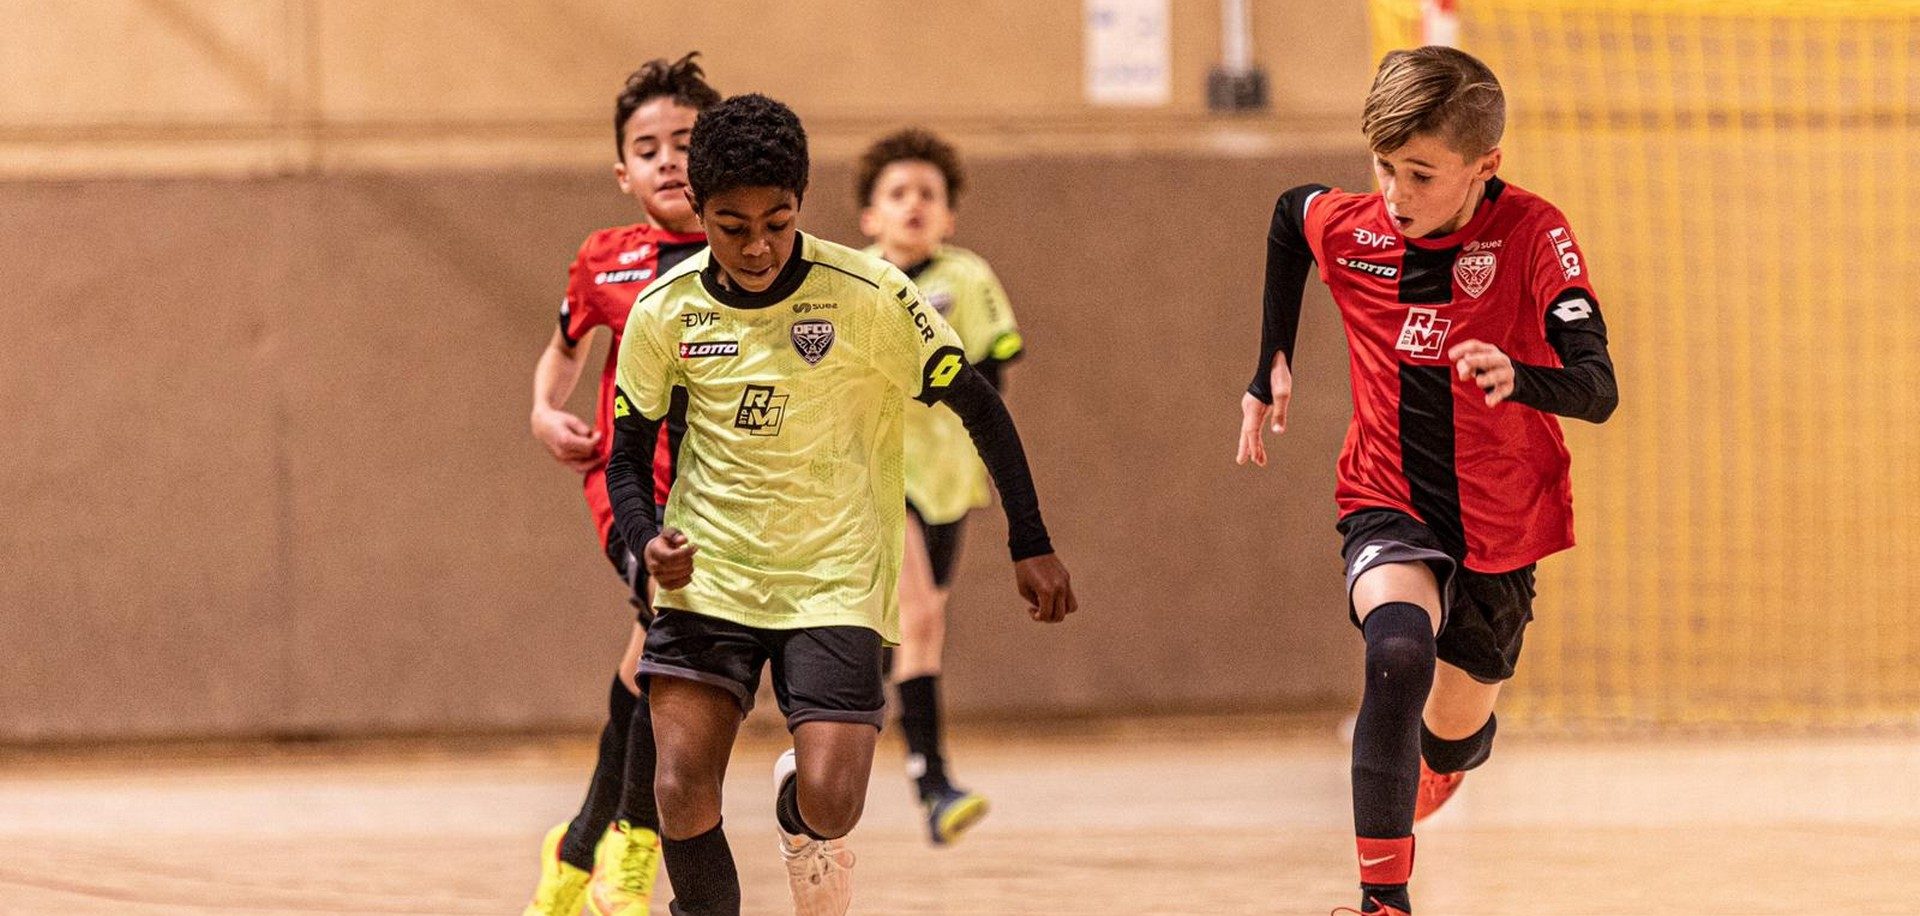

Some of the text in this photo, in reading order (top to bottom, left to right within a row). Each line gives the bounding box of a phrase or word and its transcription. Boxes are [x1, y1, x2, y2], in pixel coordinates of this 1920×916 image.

[1353, 227, 1397, 249] DVF
[1556, 240, 1581, 279] LCR
[606, 268, 653, 283] LOTTO
[1348, 260, 1398, 277] LOTTO
[681, 311, 721, 328] DVF
[906, 300, 935, 343] LCR
[688, 343, 738, 355] LOTTO
